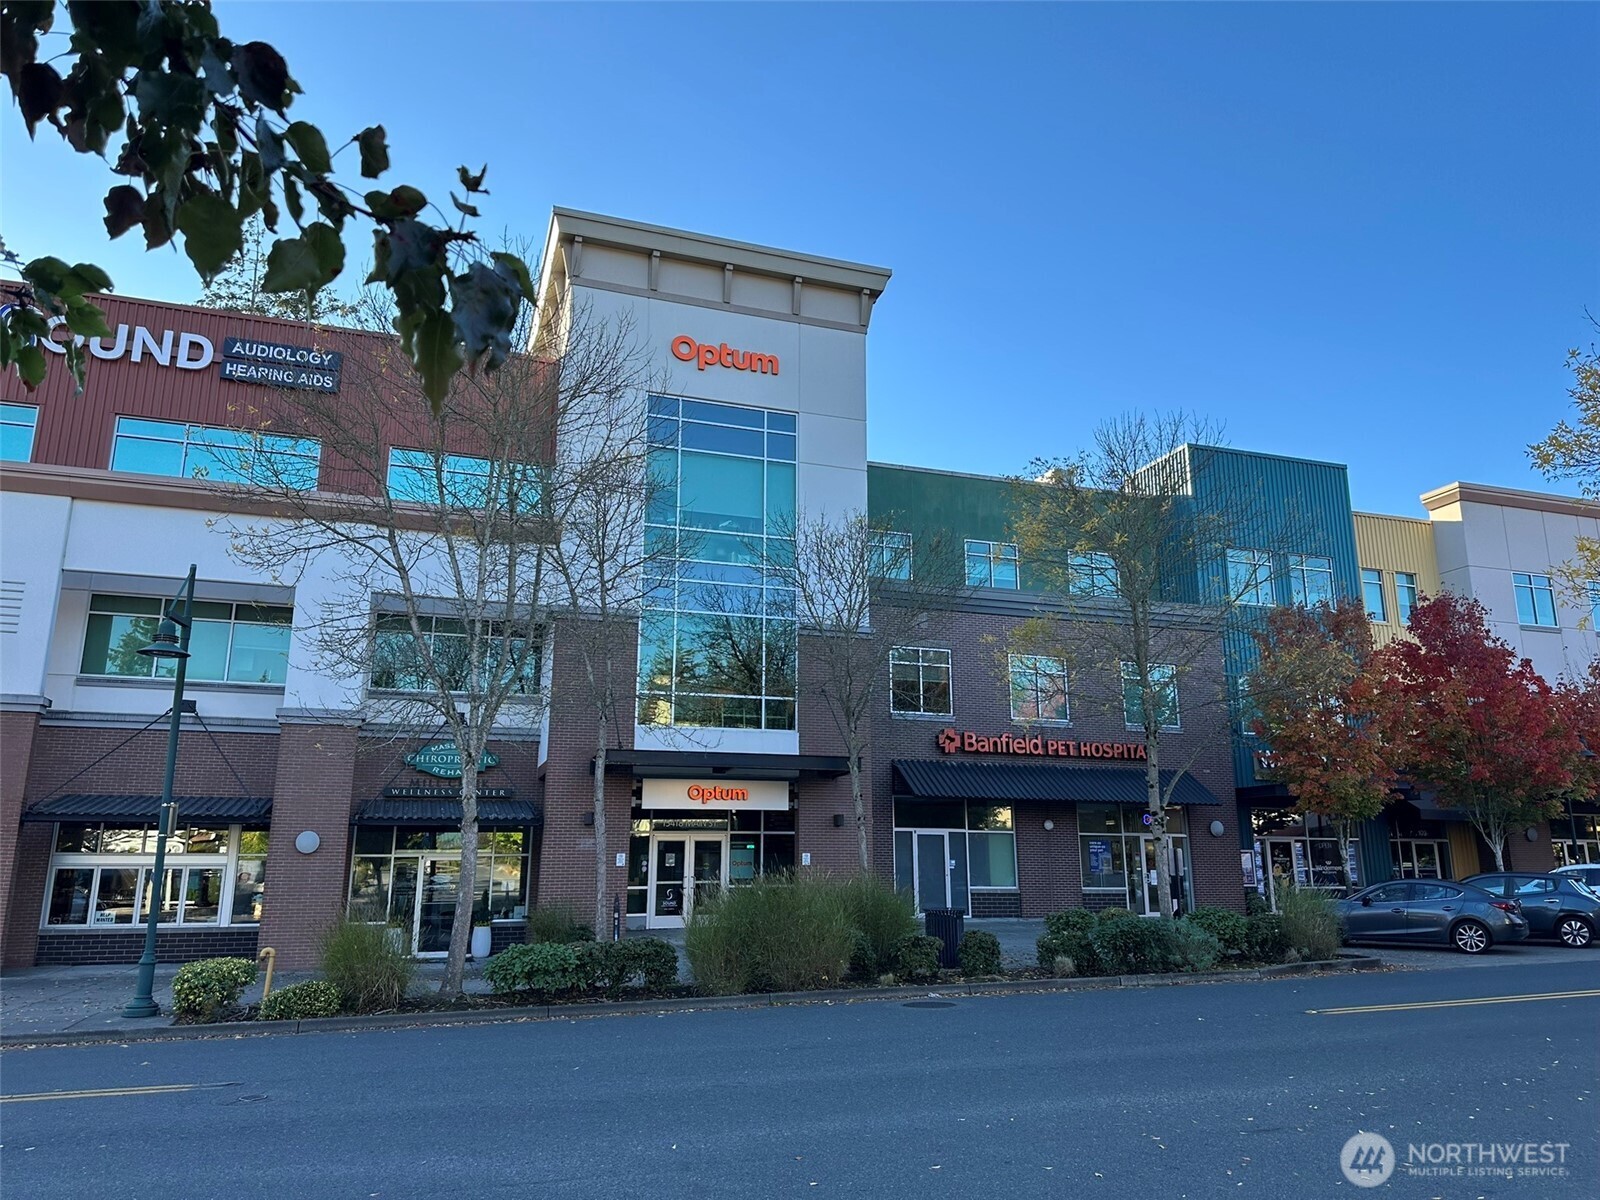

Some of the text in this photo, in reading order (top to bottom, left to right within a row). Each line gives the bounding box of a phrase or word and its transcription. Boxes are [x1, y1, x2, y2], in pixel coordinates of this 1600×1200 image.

[40, 314, 214, 370] OUND
[231, 342, 333, 365] AUDIOLOGY
[671, 335, 779, 375] Optum
[225, 362, 333, 388] HEARING AIDS
[963, 732, 1147, 760] Banfield PET HOSPITA
[432, 766, 462, 776] REHA
[391, 788, 506, 796] WELLNESS CNTER
[688, 784, 749, 804] Optum
